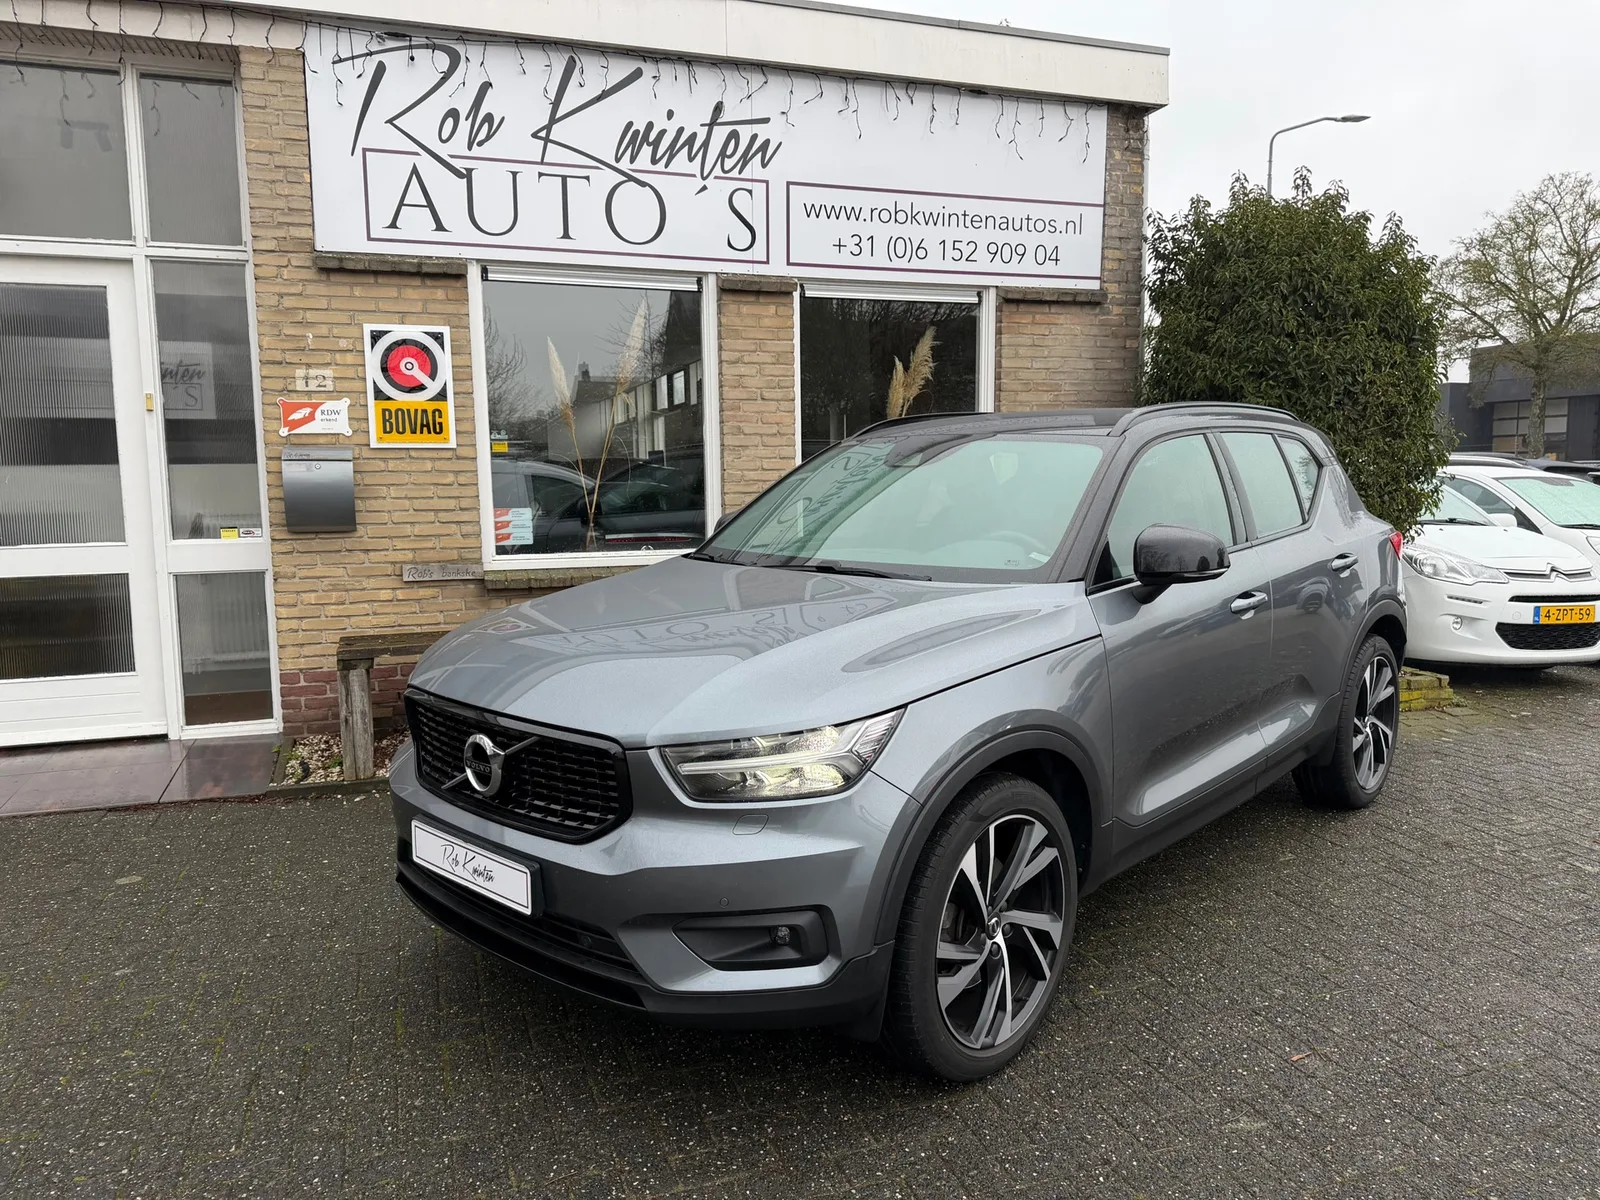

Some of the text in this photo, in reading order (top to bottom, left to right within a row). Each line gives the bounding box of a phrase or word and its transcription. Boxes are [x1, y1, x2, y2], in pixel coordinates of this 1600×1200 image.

[331, 43, 783, 188] Rob Kwinten
[803, 200, 1083, 235] www.robkwintenautos.nl
[832, 233, 1061, 266] +31 (0)6 152 909 04
[381, 407, 444, 435] BOVAG
[407, 566, 476, 580] Rob's bankske
[1544, 608, 1591, 621] 4-ZPT-59
[466, 760, 491, 773] VOLVO
[440, 843, 496, 882] Rob Kwinten
